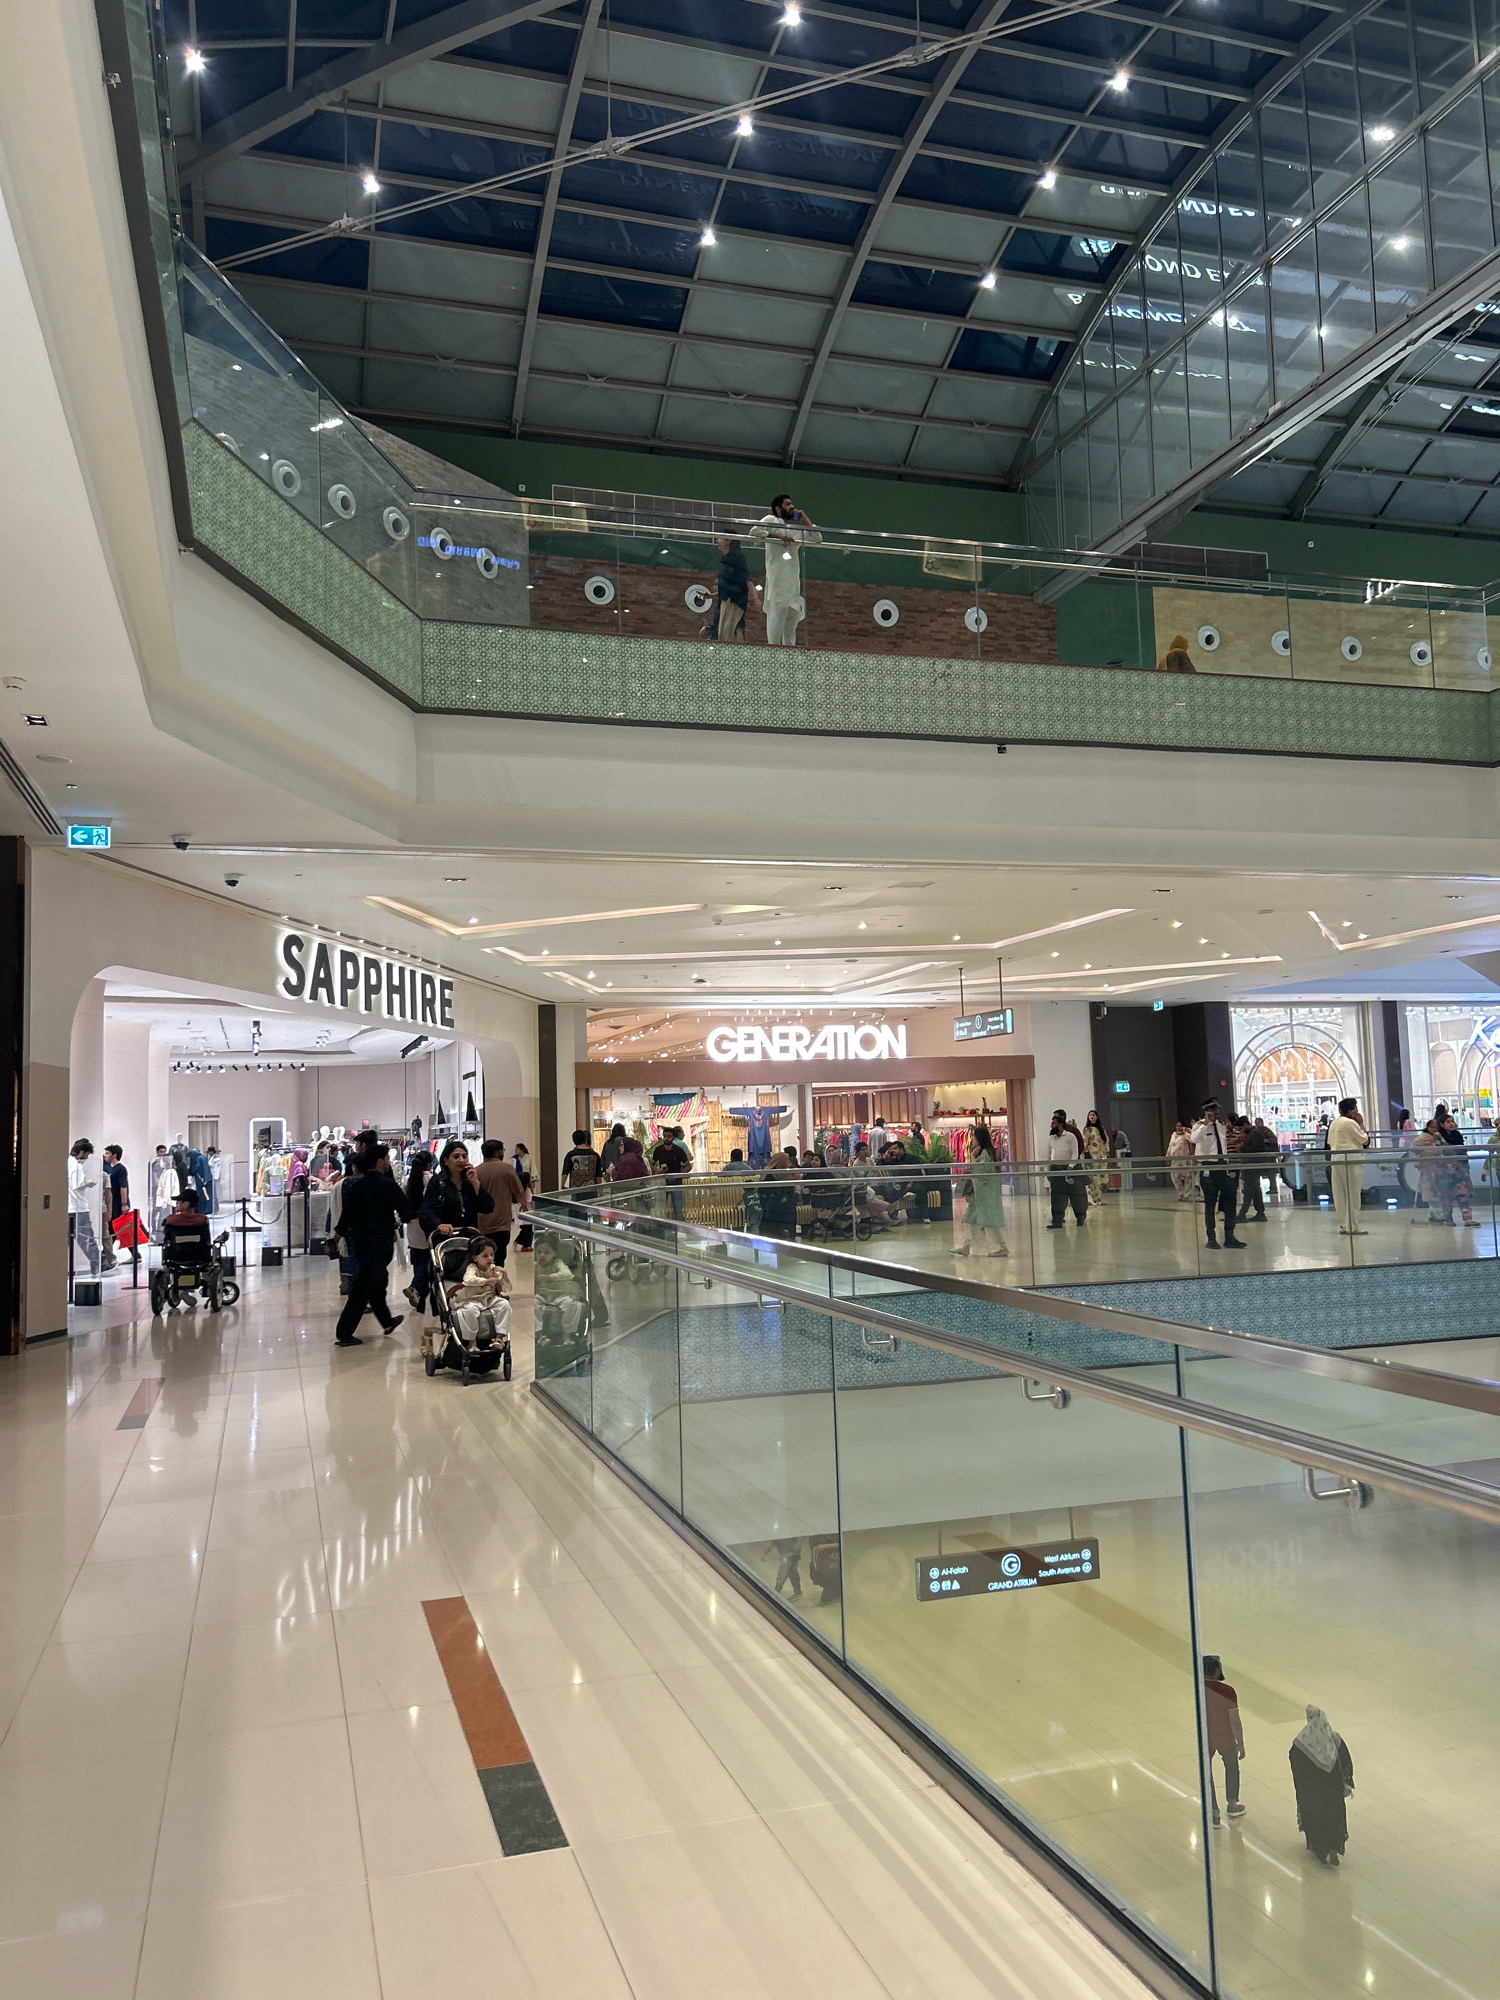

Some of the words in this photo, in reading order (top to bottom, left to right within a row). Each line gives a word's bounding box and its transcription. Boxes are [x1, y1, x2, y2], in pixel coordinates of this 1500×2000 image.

[281, 932, 455, 1029] SAPPHIRE
[706, 1024, 907, 1062] GENERATION
[1044, 1554, 1059, 1563] West
[1060, 1552, 1080, 1561] Atrium
[941, 1565, 969, 1576] Al-Falah
[1038, 1568, 1056, 1578] South
[1057, 1566, 1081, 1576] Avenue
[988, 1581, 1012, 1590] GRAND
[1013, 1578, 1037, 1588] ATRIUM
